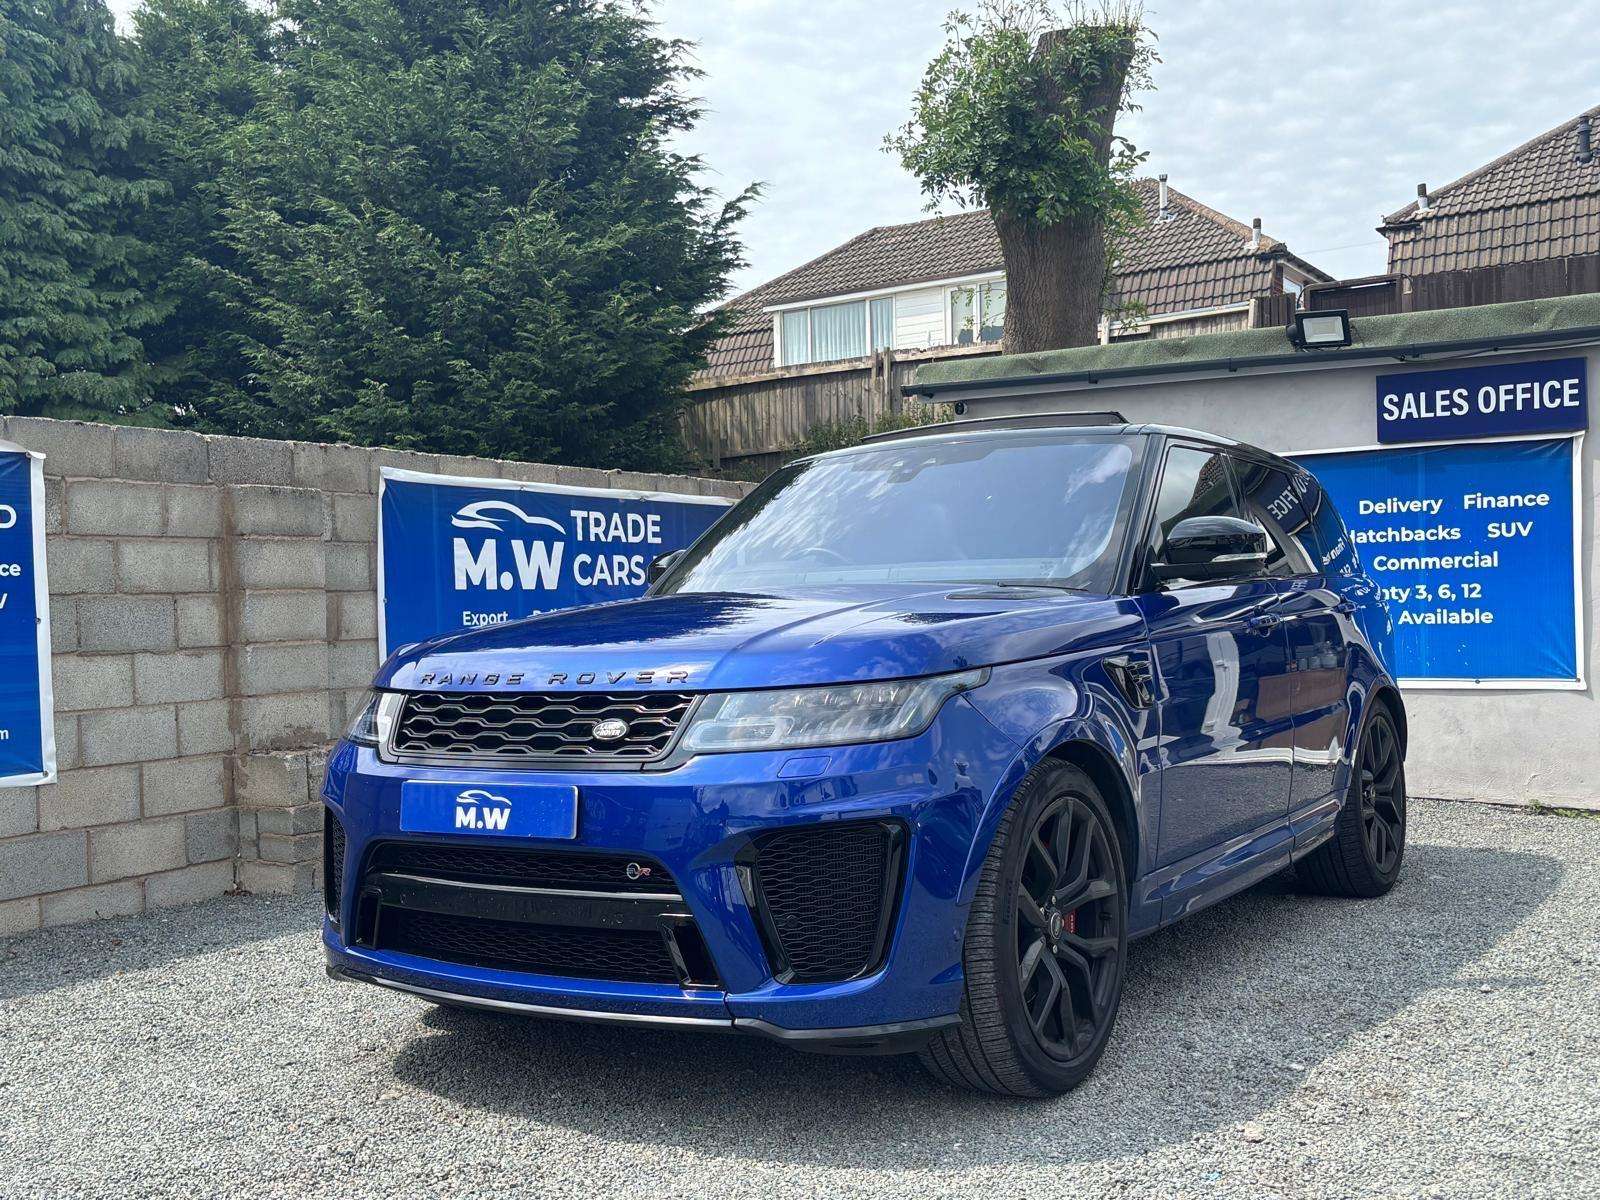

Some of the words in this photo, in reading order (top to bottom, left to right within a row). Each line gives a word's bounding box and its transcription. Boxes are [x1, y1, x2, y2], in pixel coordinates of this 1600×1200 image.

[1383, 388, 1469, 421] SALES
[1477, 378, 1580, 414] OFFICE
[1359, 498, 1443, 515] Delivery
[1463, 492, 1550, 509] Finance
[570, 509, 662, 544] TRADE
[1487, 521, 1533, 538] SUV
[453, 537, 565, 591] M.W
[573, 554, 646, 586] CARS
[1373, 551, 1498, 571] Commercial
[1415, 584, 1433, 602] 3,
[1438, 583, 1456, 602] 6,
[1461, 583, 1482, 598] 12
[462, 611, 508, 626] Export
[1398, 608, 1494, 625] Available
[419, 672, 524, 685] RANGE
[548, 671, 689, 684] ROVER
[455, 806, 511, 830] M.W
